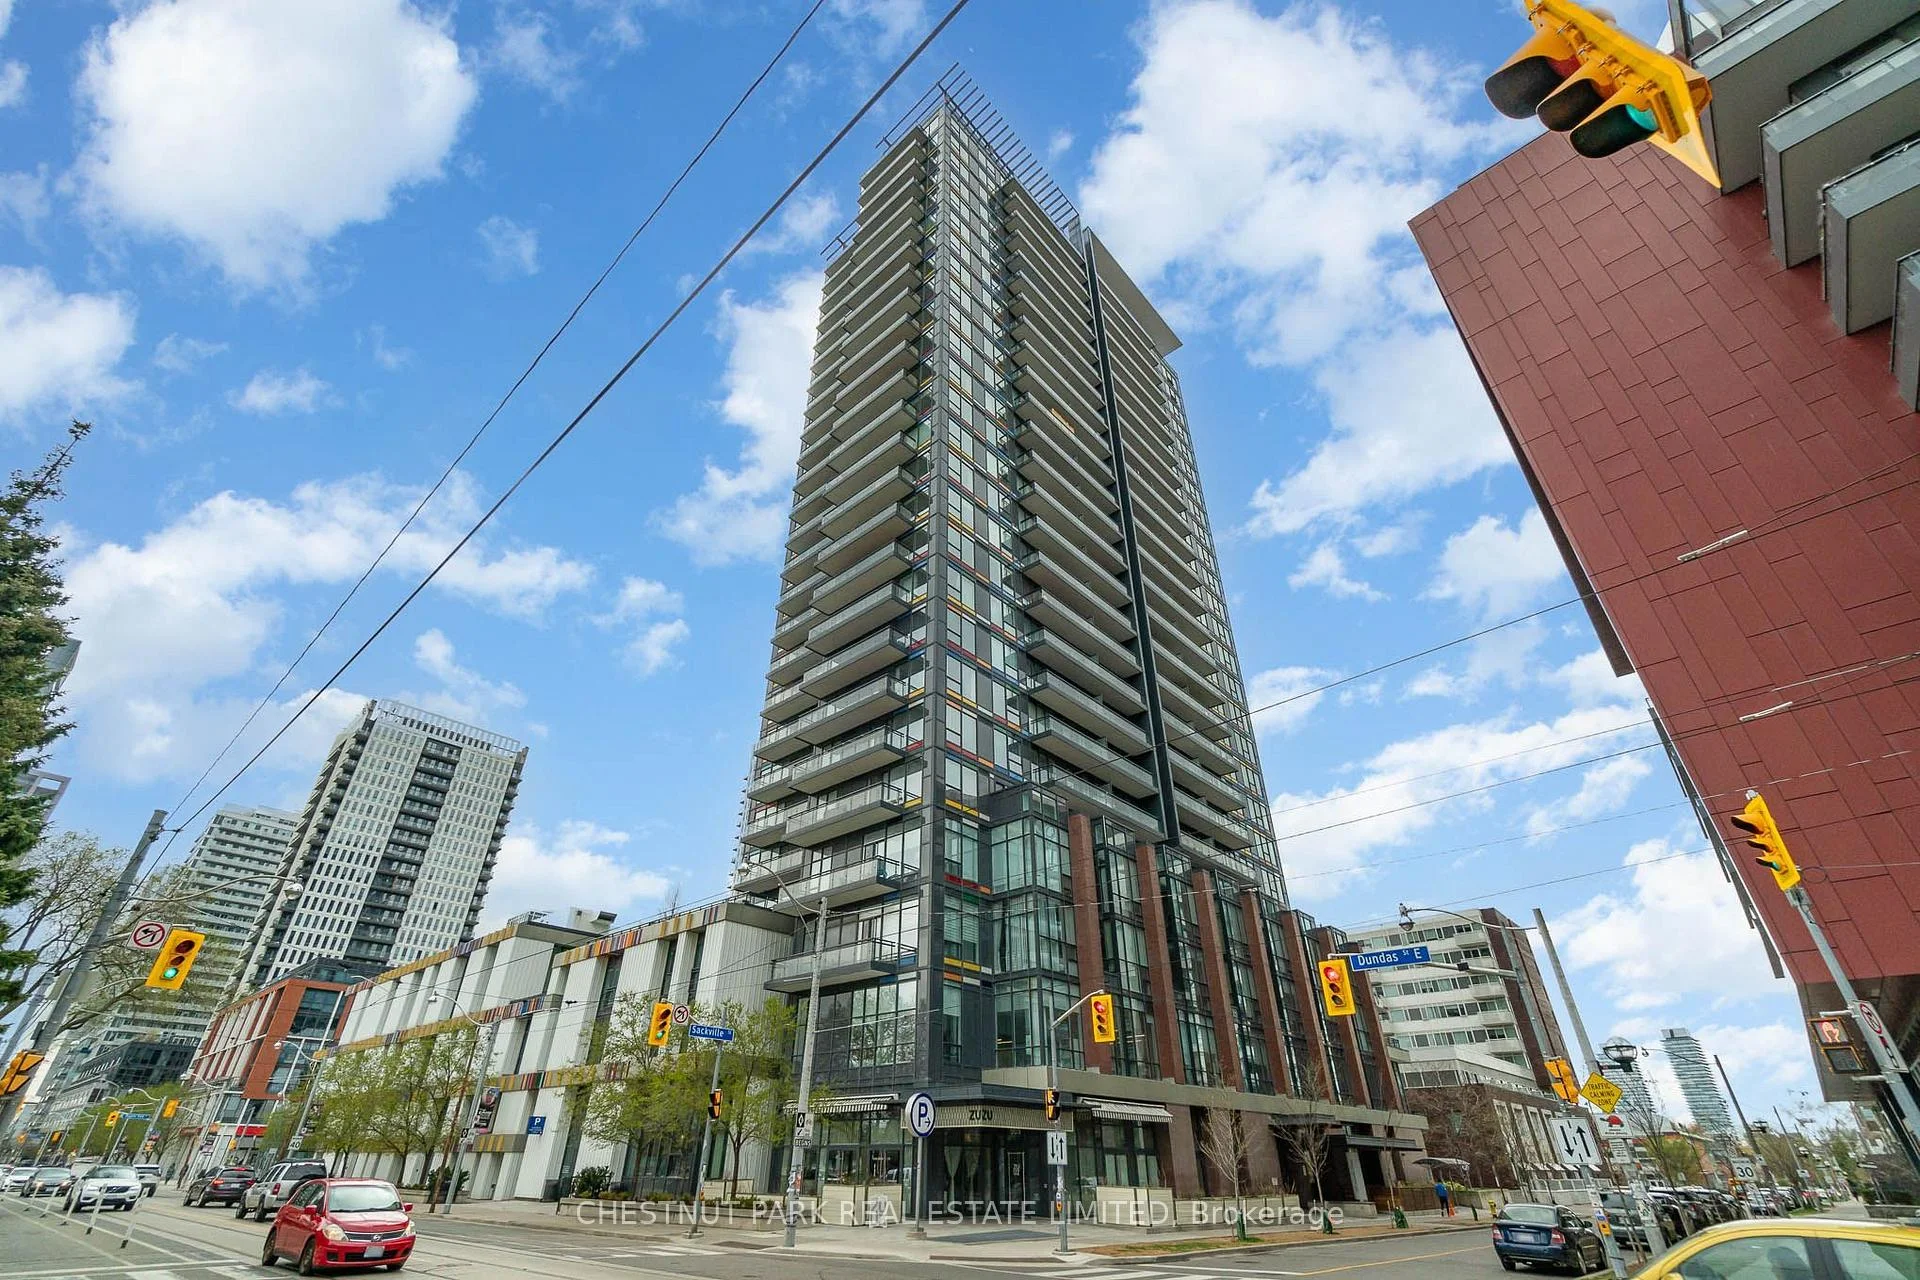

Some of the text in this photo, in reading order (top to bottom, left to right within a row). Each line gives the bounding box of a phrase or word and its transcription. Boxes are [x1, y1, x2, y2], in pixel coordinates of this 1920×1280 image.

[1357, 952, 1399, 966] Dundas
[1414, 947, 1422, 959] E
[692, 1025, 725, 1037] Sackville
[918, 1102, 928, 1127] P
[969, 1109, 993, 1121] ZUZU
[535, 1117, 541, 1126] P
[1736, 1166, 1754, 1178] 30
